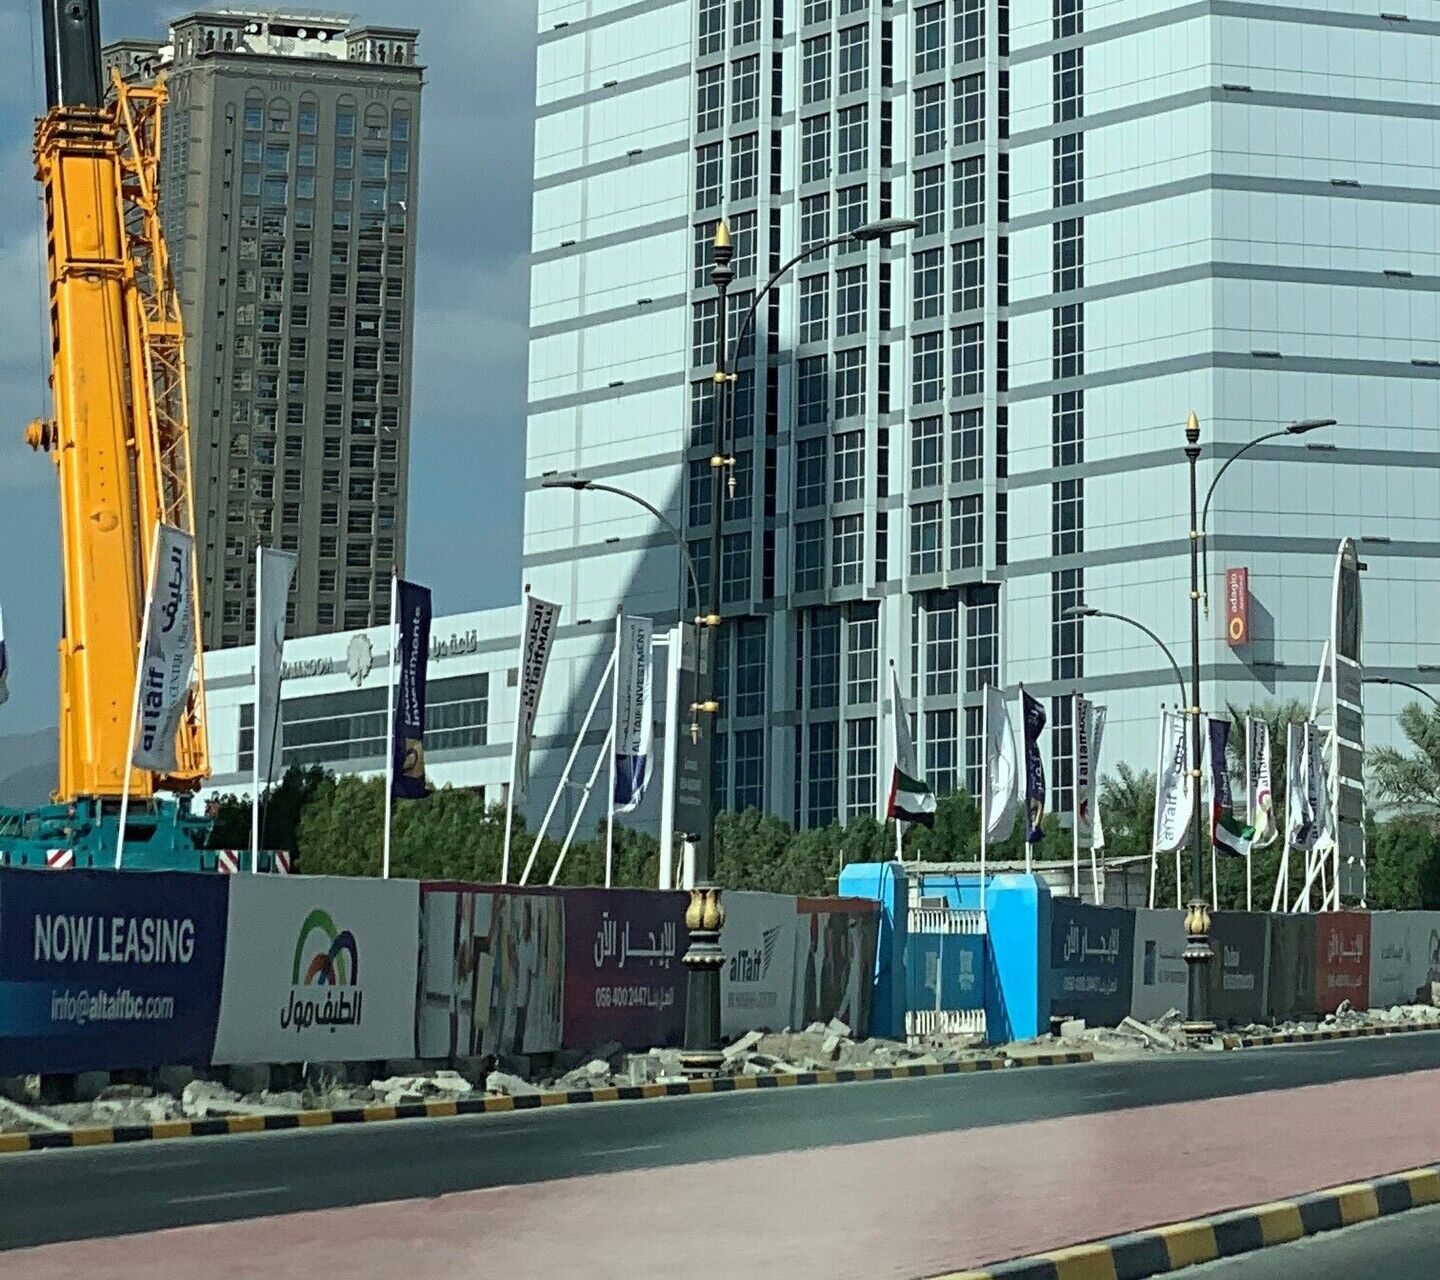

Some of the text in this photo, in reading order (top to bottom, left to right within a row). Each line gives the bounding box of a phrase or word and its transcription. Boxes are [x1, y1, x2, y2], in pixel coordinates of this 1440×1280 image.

[34, 914, 195, 963] NOW LEASING
[51, 989, 174, 1025] info@altaifbc.com
[280, 990, 362, 1033] الطيف مول
